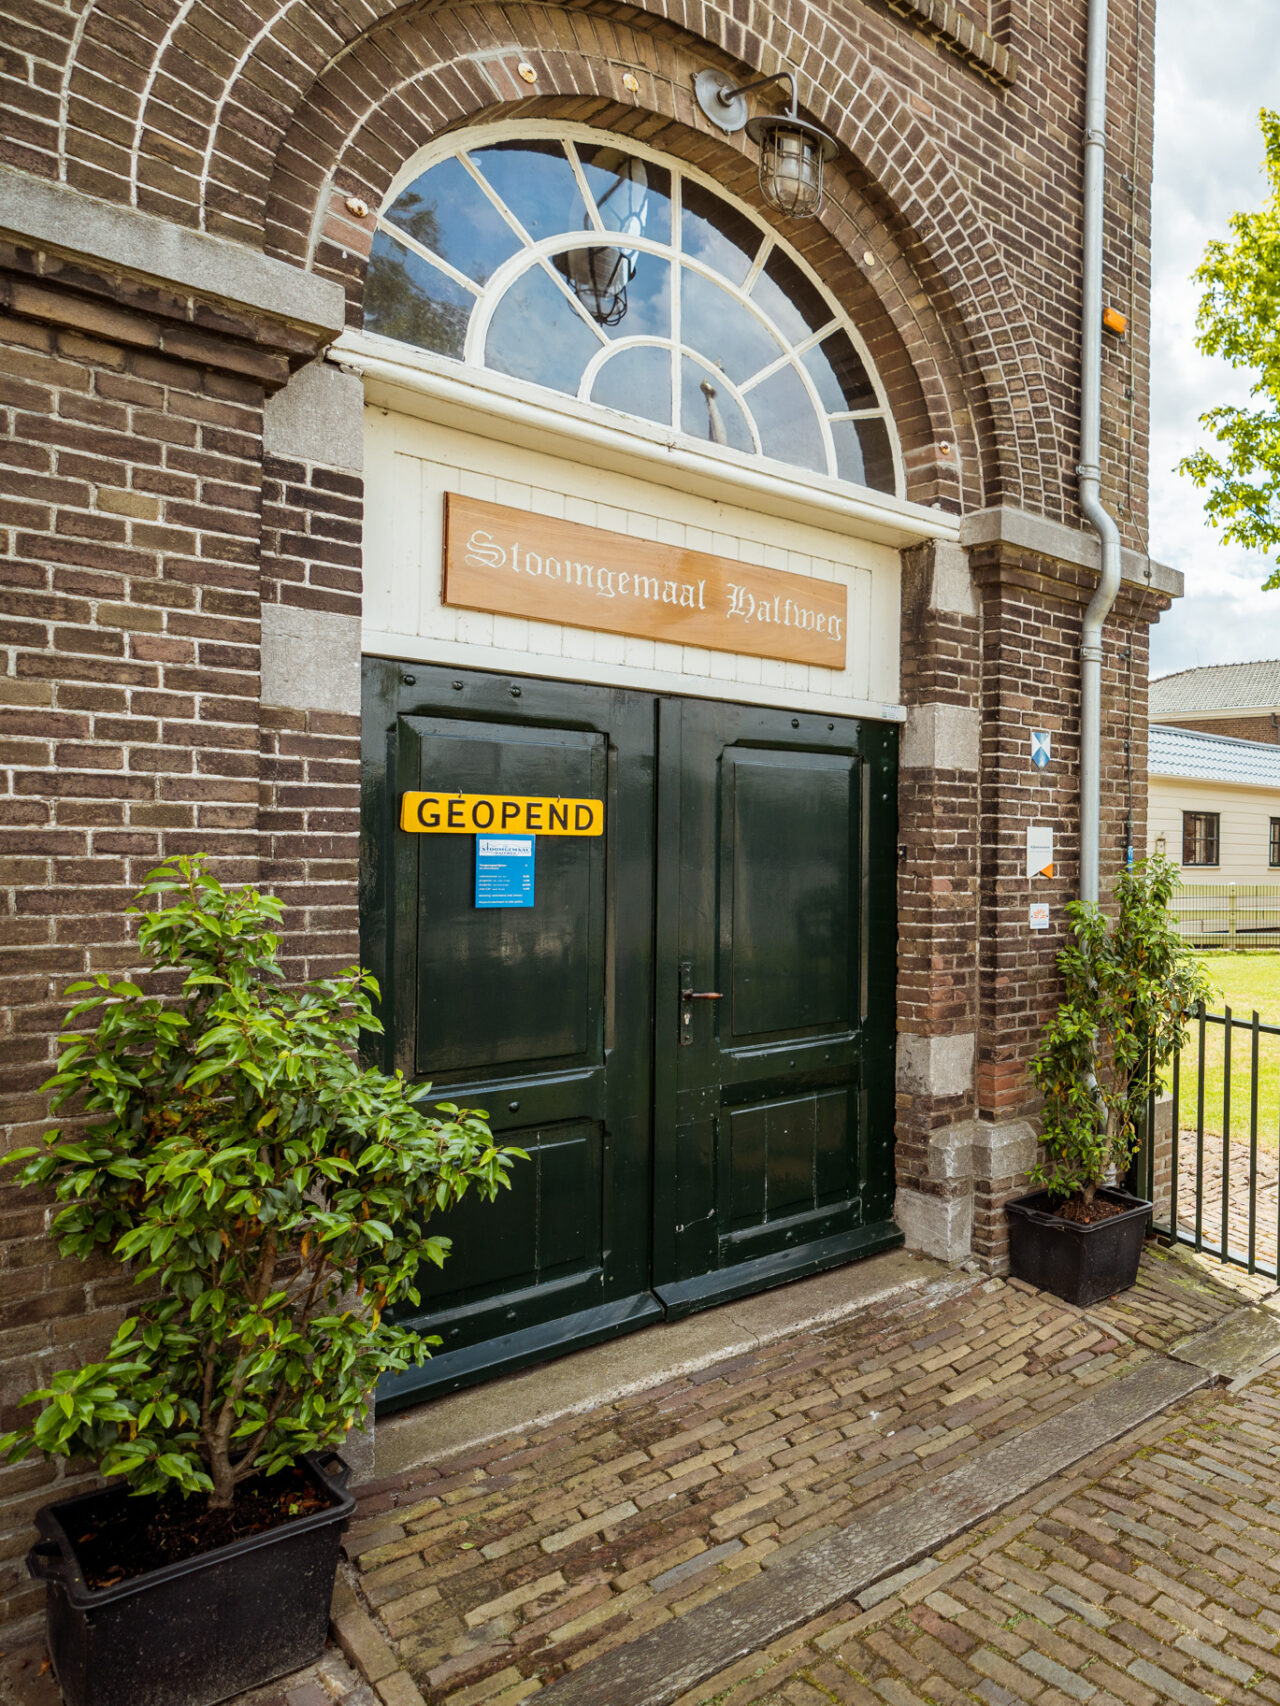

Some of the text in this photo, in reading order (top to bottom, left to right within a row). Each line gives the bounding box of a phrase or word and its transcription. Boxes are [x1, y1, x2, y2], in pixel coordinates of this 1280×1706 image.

[464, 529, 843, 642] Stoomgemaal Halfweg
[417, 797, 595, 831] GEOPEND
